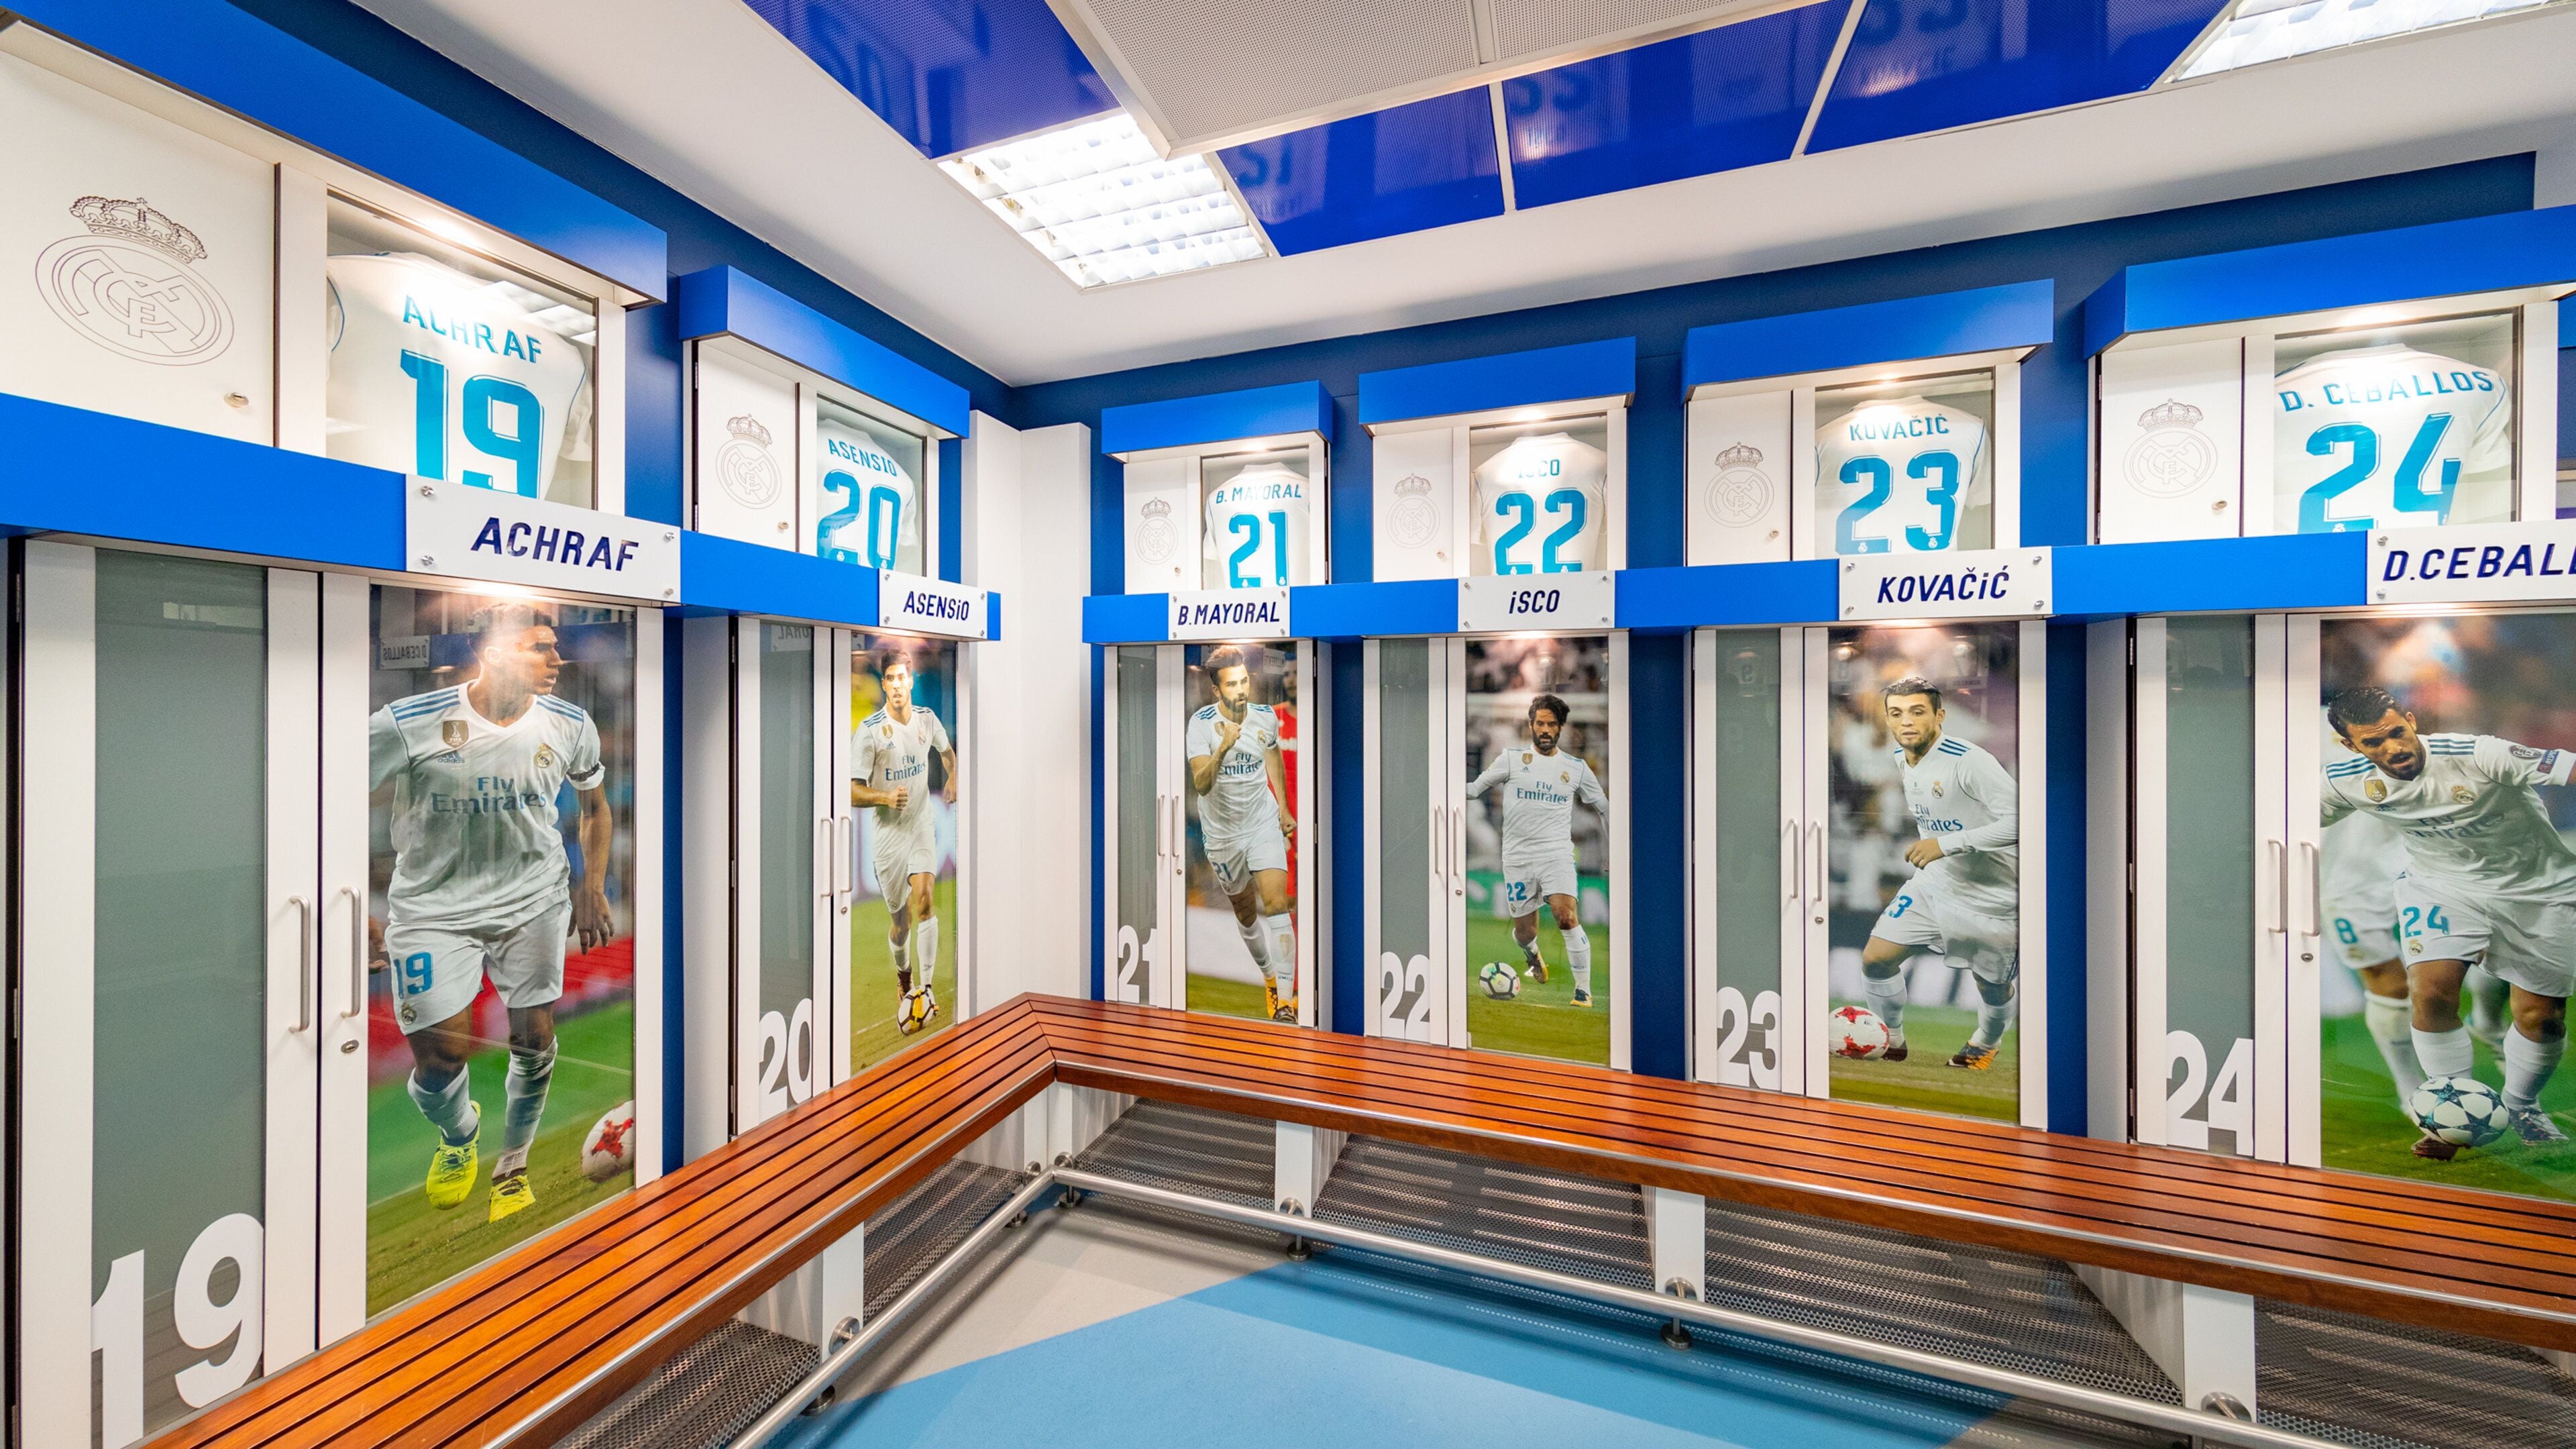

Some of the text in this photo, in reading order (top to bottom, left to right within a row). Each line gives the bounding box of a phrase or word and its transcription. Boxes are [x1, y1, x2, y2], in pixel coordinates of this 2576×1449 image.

[2279, 371, 2493, 412] D. CEBALLOS
[400, 348, 545, 499] 19
[827, 437, 898, 478] ASENSIO
[2298, 412, 2464, 534] 24
[817, 469, 901, 569] 20
[1216, 490, 1228, 504] B.
[1835, 449, 1960, 555] 23
[470, 517, 639, 572] ACHRAF
[1228, 510, 1289, 588] 21
[1495, 488, 1587, 576] 22
[1177, 601, 1281, 625] B.MAYORAL
[902, 755, 915, 765] Fly
[1236, 752, 1251, 763] Fly
[431, 792, 546, 814] Emirates
[478, 776, 515, 792] Fly
[1517, 787, 1568, 804] Emirates
[1536, 781, 1552, 792] Fly
[1212, 861, 1233, 881] 21
[1506, 881, 1527, 902] 22
[1882, 895, 1913, 918] 3
[2402, 905, 2450, 938] 24
[393, 952, 433, 1000] 19
[1118, 924, 1157, 1006] 21
[1381, 951, 1430, 1042] 22
[1717, 986, 1781, 1091] 23
[759, 998, 812, 1125] 20
[2166, 1030, 2253, 1157] 24
[91, 1213, 264, 1449] 19
